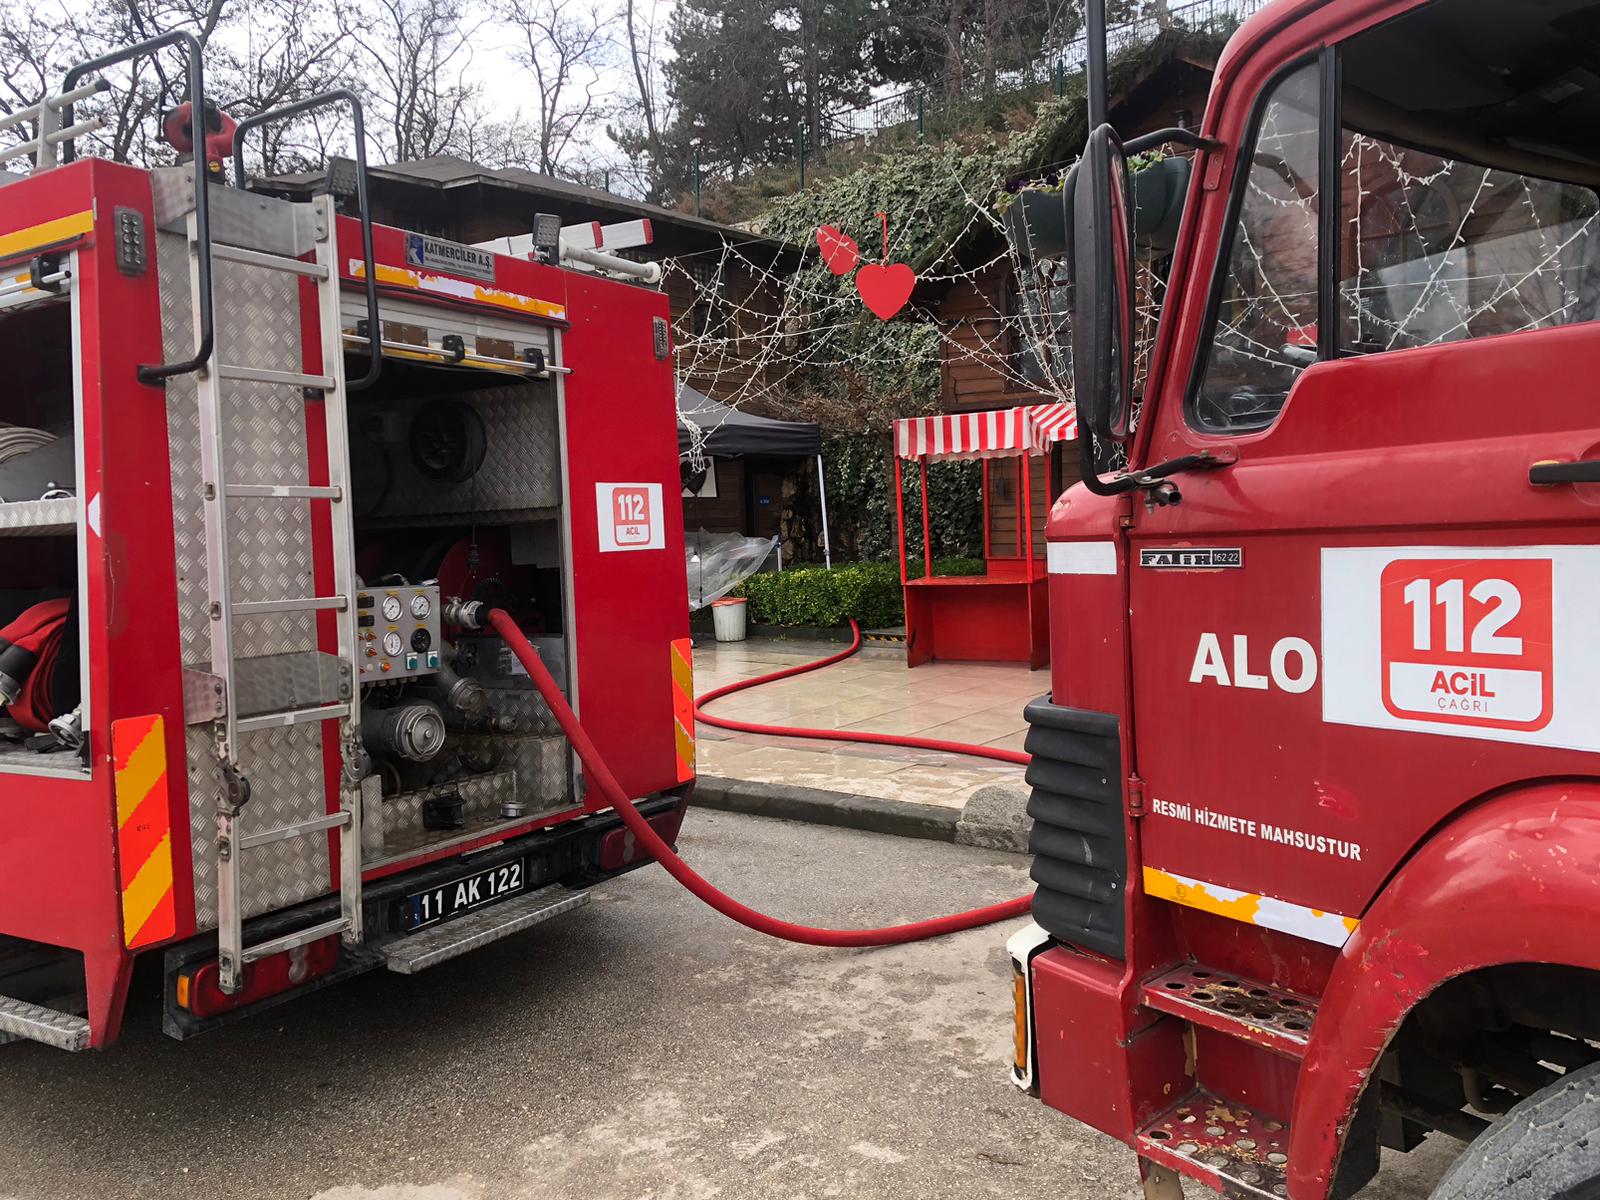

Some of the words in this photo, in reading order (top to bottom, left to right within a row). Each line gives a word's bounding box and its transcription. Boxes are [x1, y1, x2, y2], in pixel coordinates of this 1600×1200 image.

[618, 494, 645, 521] 112
[1403, 578, 1523, 656] 112
[1188, 632, 1318, 694] ALO
[1437, 697, 1488, 713] ÇAĞRI
[1152, 798, 1192, 822] RESMİ
[1194, 805, 1257, 837] HİZMETE
[1260, 823, 1362, 862] MAHSUSTUR
[421, 890, 443, 919] 11
[454, 877, 481, 909] AK
[488, 864, 520, 895] 122
